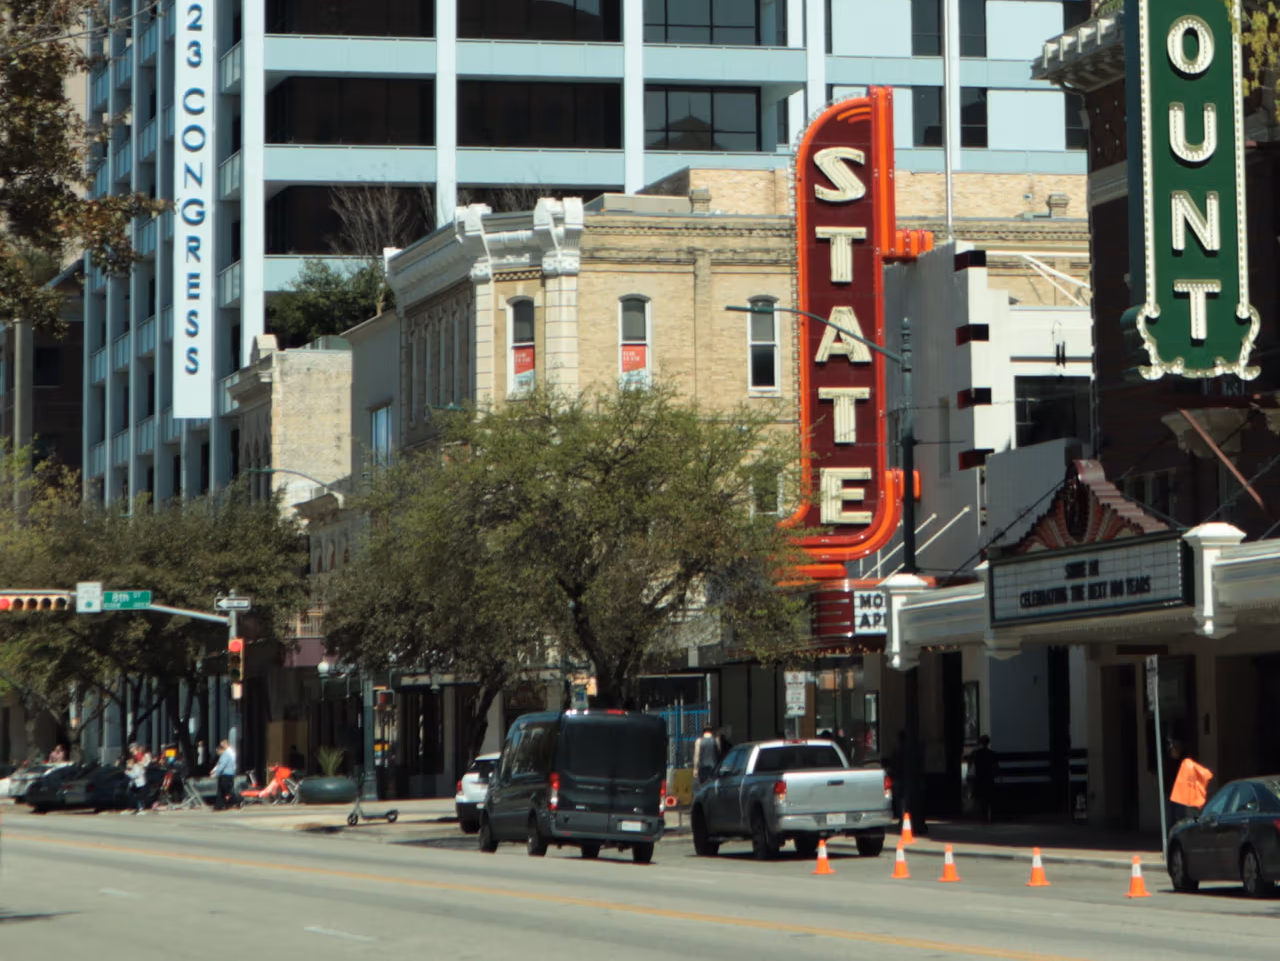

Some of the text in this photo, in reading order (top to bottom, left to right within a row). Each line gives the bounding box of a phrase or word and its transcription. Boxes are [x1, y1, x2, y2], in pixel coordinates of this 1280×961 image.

[181, 87, 206, 377] CONGRESS
[813, 146, 873, 525] STATE
[1088, 581, 1108, 600] NEXT
